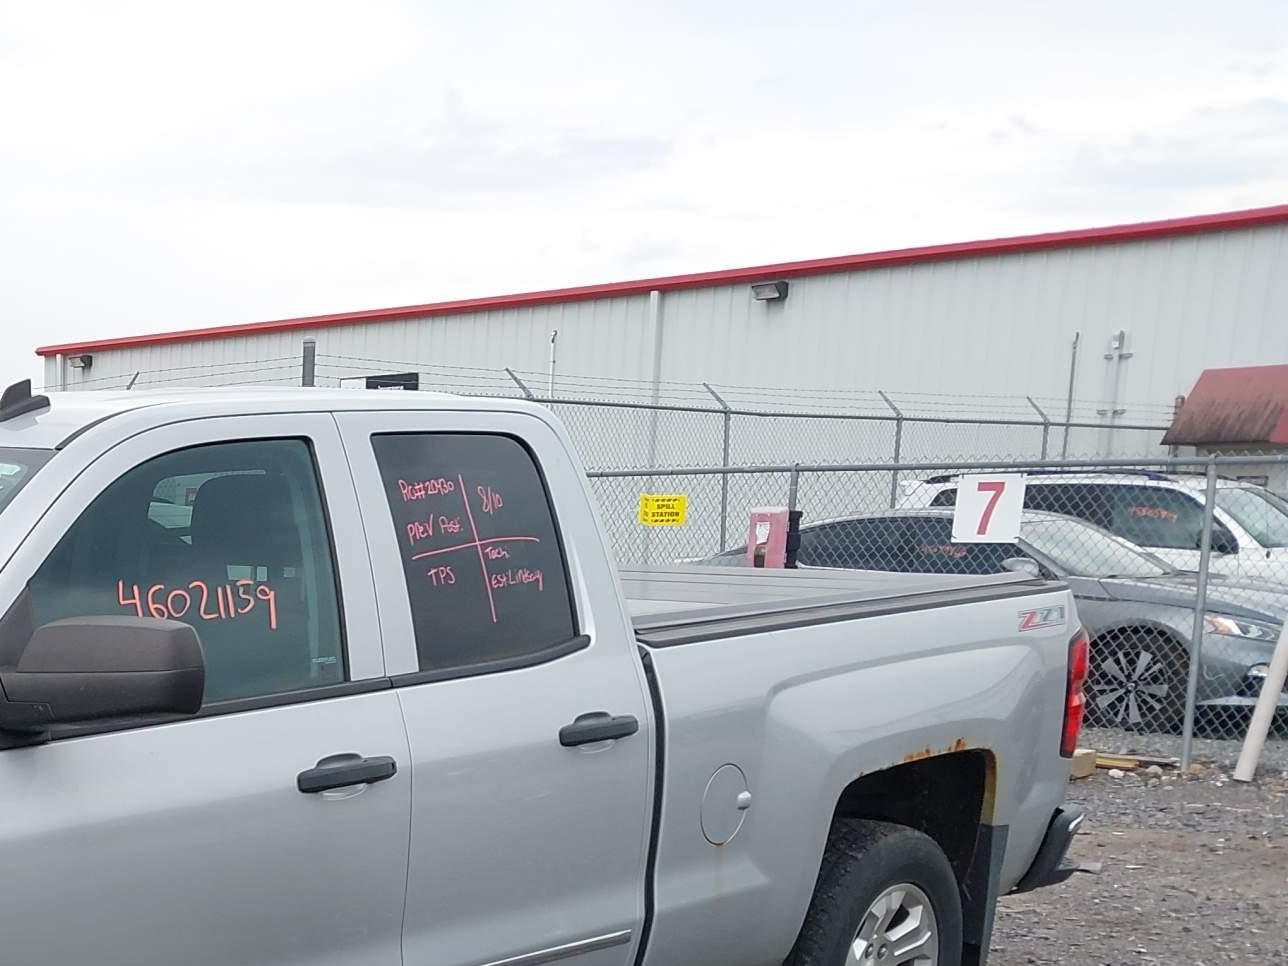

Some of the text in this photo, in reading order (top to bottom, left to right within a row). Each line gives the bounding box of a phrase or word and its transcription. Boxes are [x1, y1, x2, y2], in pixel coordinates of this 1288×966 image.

[976, 481, 1006, 535] 7
[427, 566, 456, 586] TPS
[117, 579, 278, 630] 46021159
[1017, 605, 1065, 632] Z71
